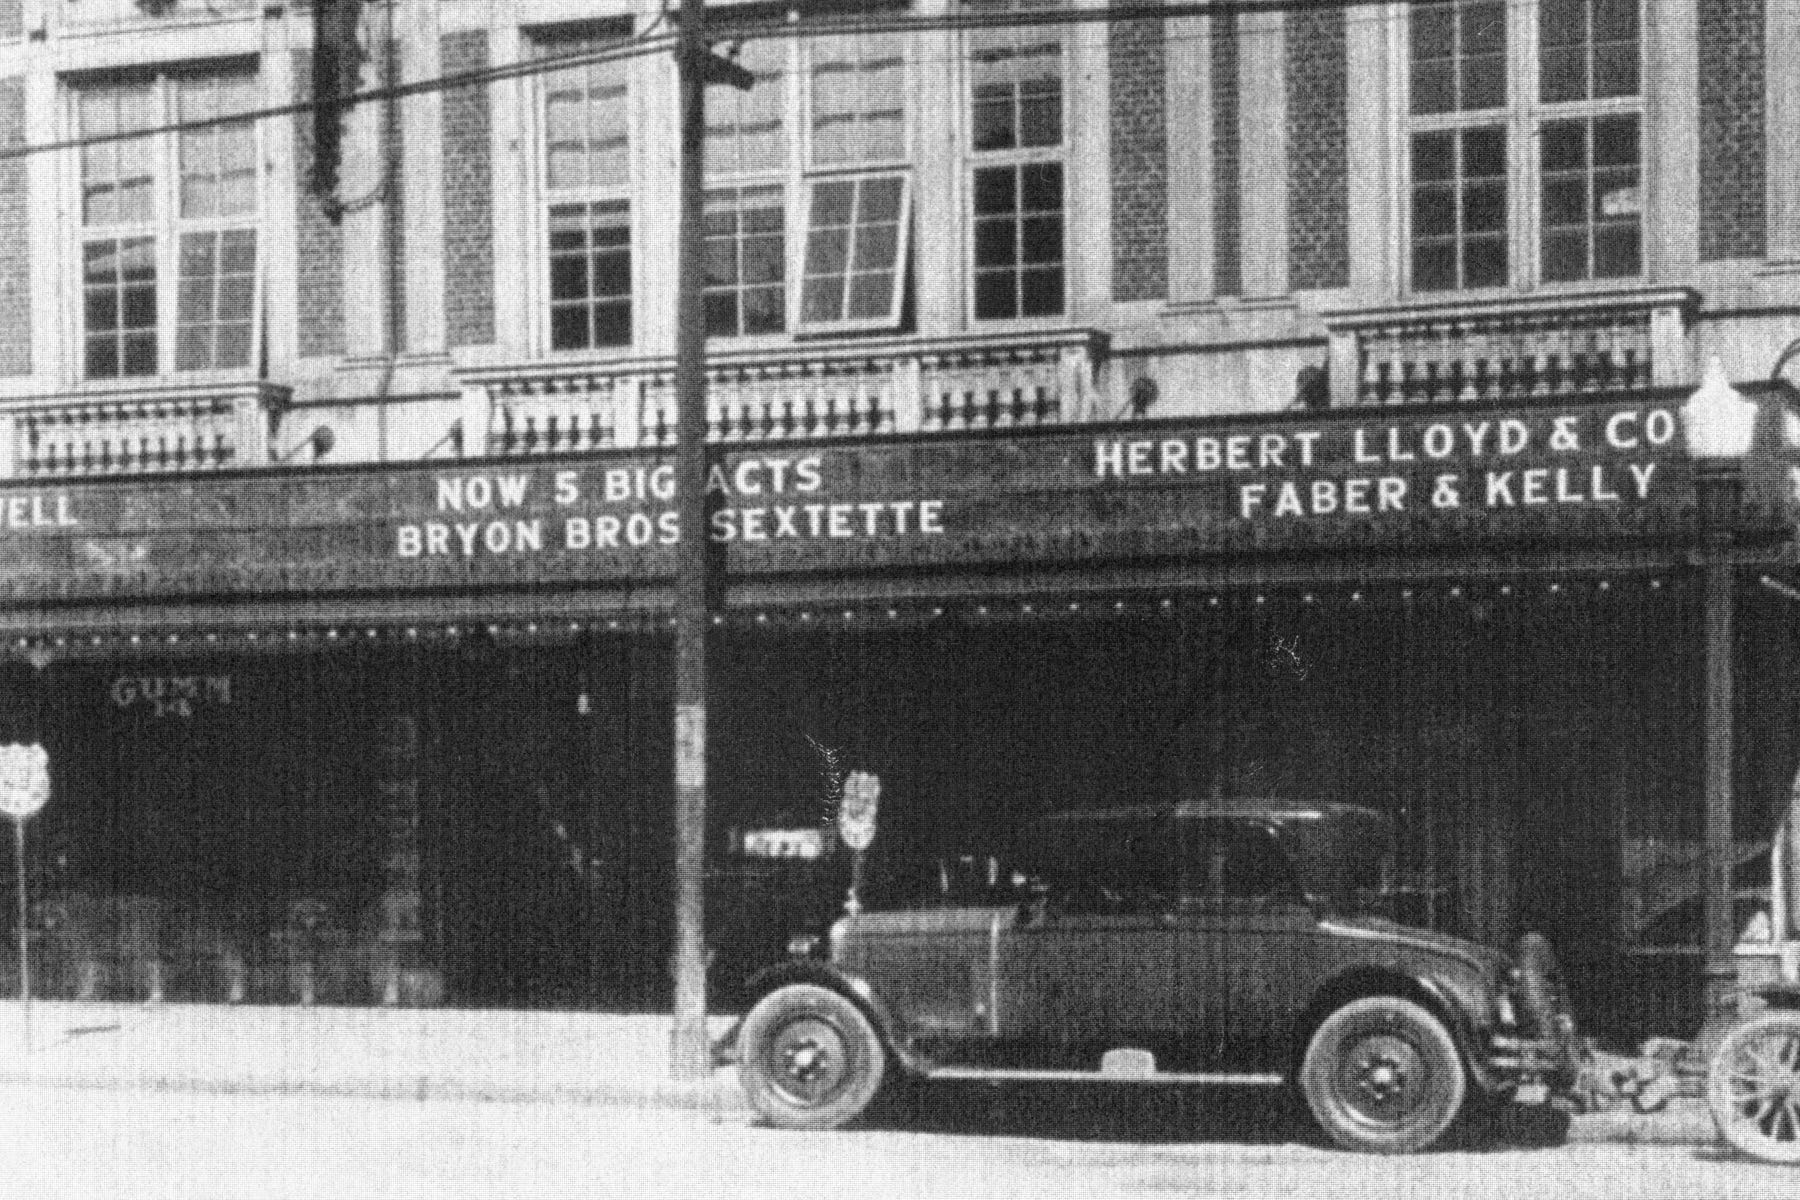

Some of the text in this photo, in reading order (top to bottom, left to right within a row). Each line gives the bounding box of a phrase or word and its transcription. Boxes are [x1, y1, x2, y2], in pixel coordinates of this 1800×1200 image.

[1096, 409, 1675, 477] HERBERT LLOYD & CO
[0, 495, 78, 529] ELL
[437, 456, 823, 512] NOW 5 BIG ACTS
[1241, 463, 1655, 518] FABER & KELLY
[398, 500, 944, 557] BRYON BROS SEXTETTE
